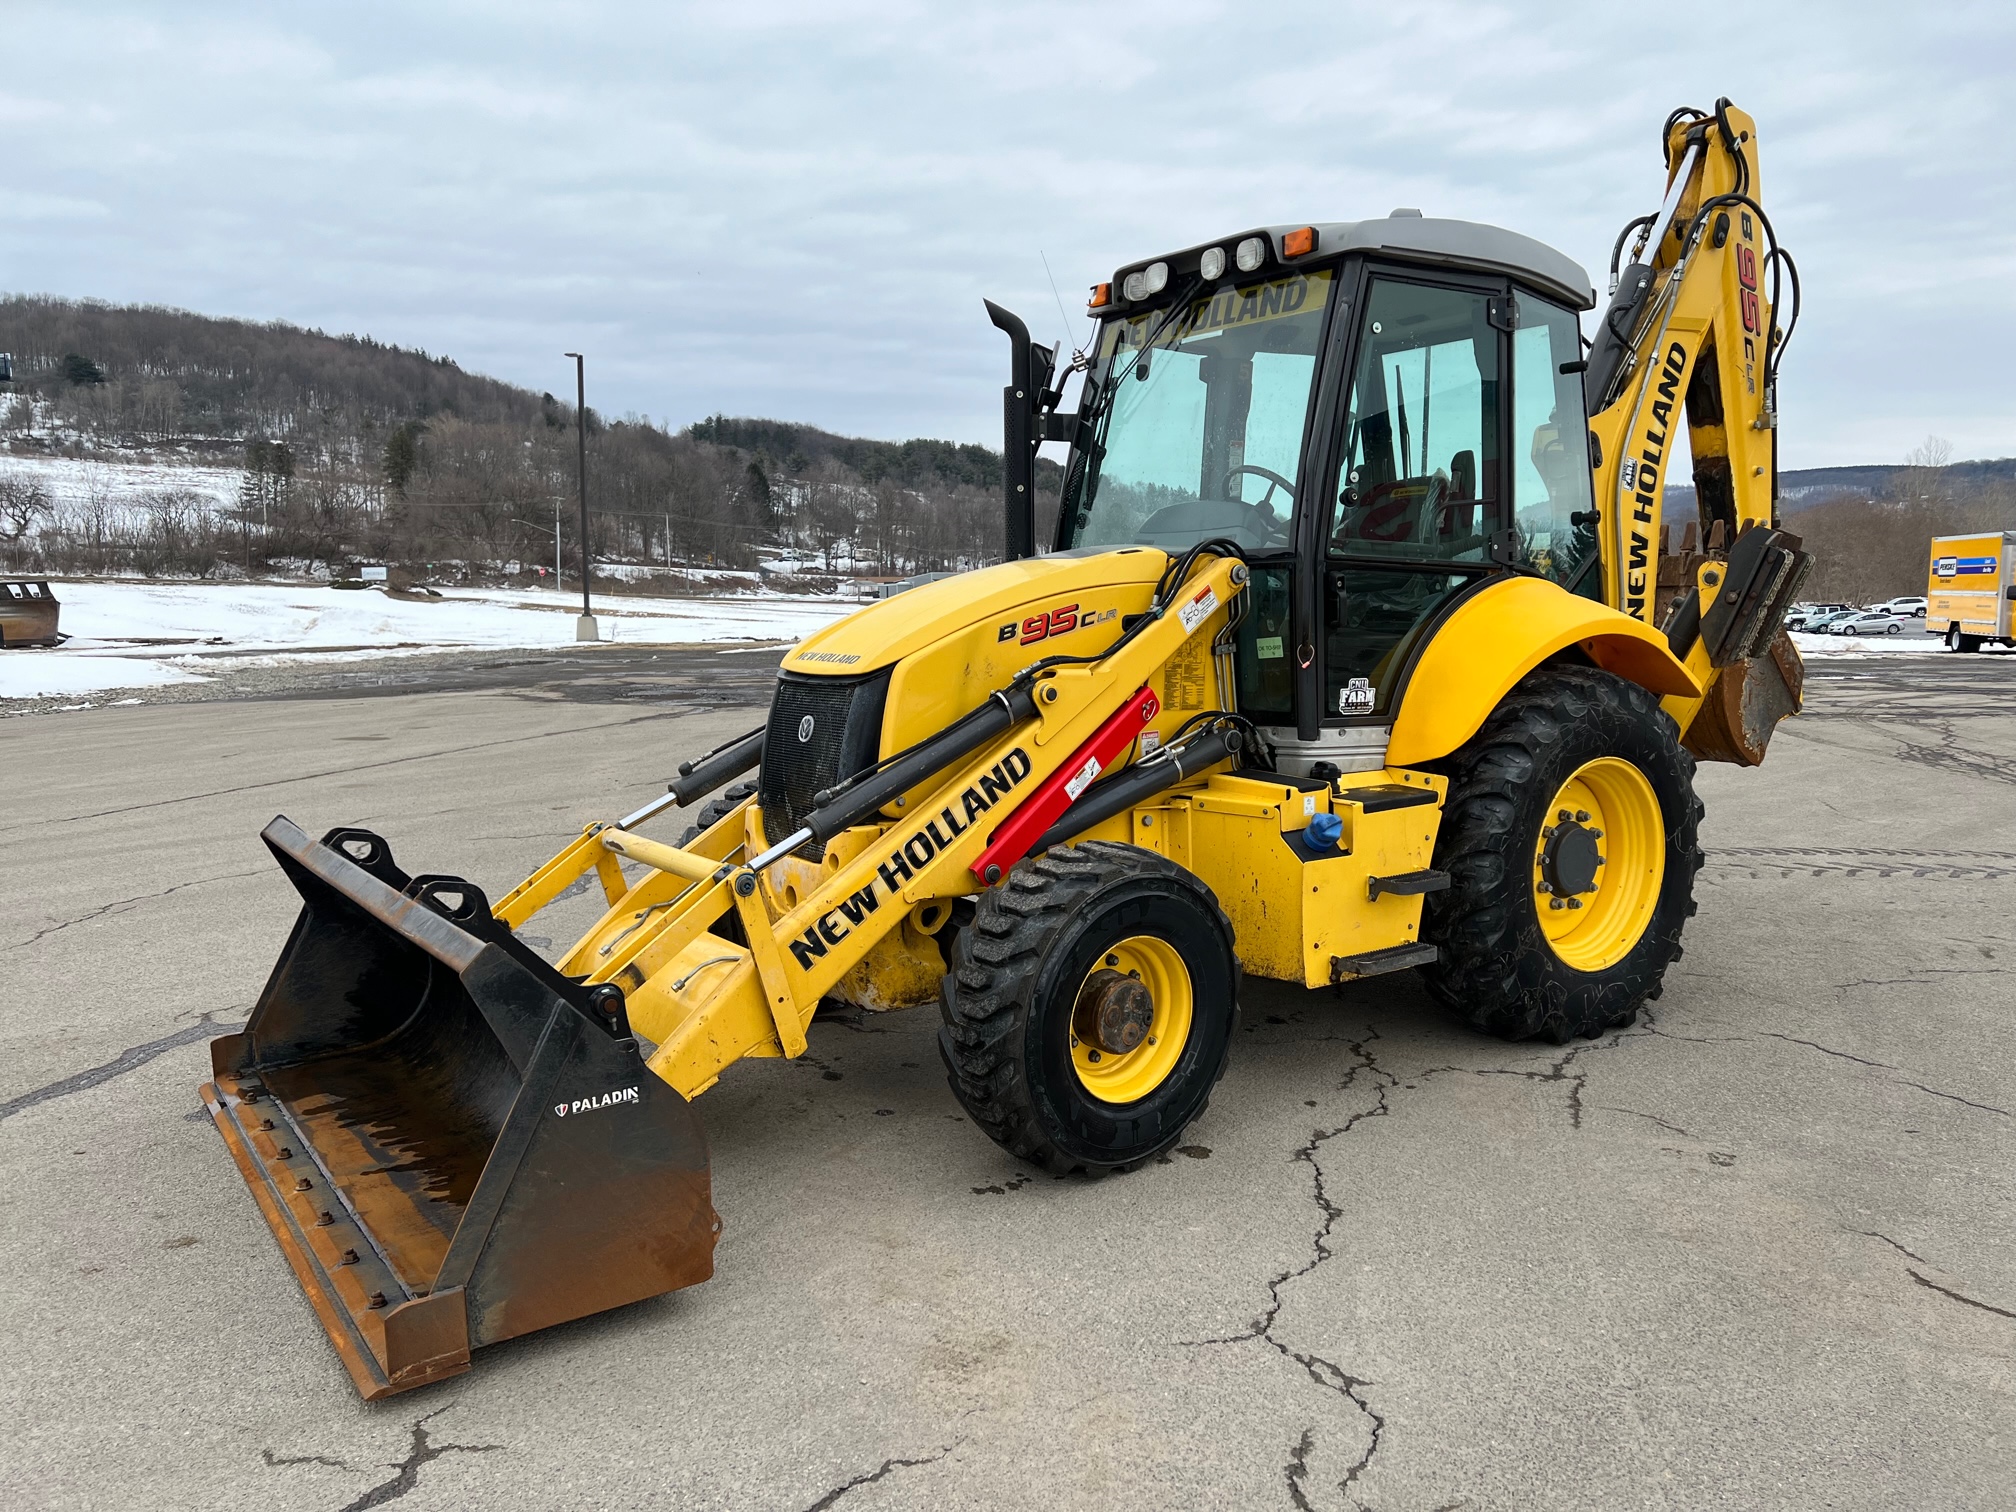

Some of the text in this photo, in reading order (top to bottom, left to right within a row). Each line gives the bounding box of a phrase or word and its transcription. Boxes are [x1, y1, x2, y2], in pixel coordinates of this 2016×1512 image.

[1627, 342, 1687, 621] NEW HOLLAND
[796, 651, 861, 664] NEW HOLLAND
[1341, 690, 1374, 702] FARM
[788, 747, 1032, 971] NEW HOLLAND
[571, 1086, 639, 1113] PALADIN
